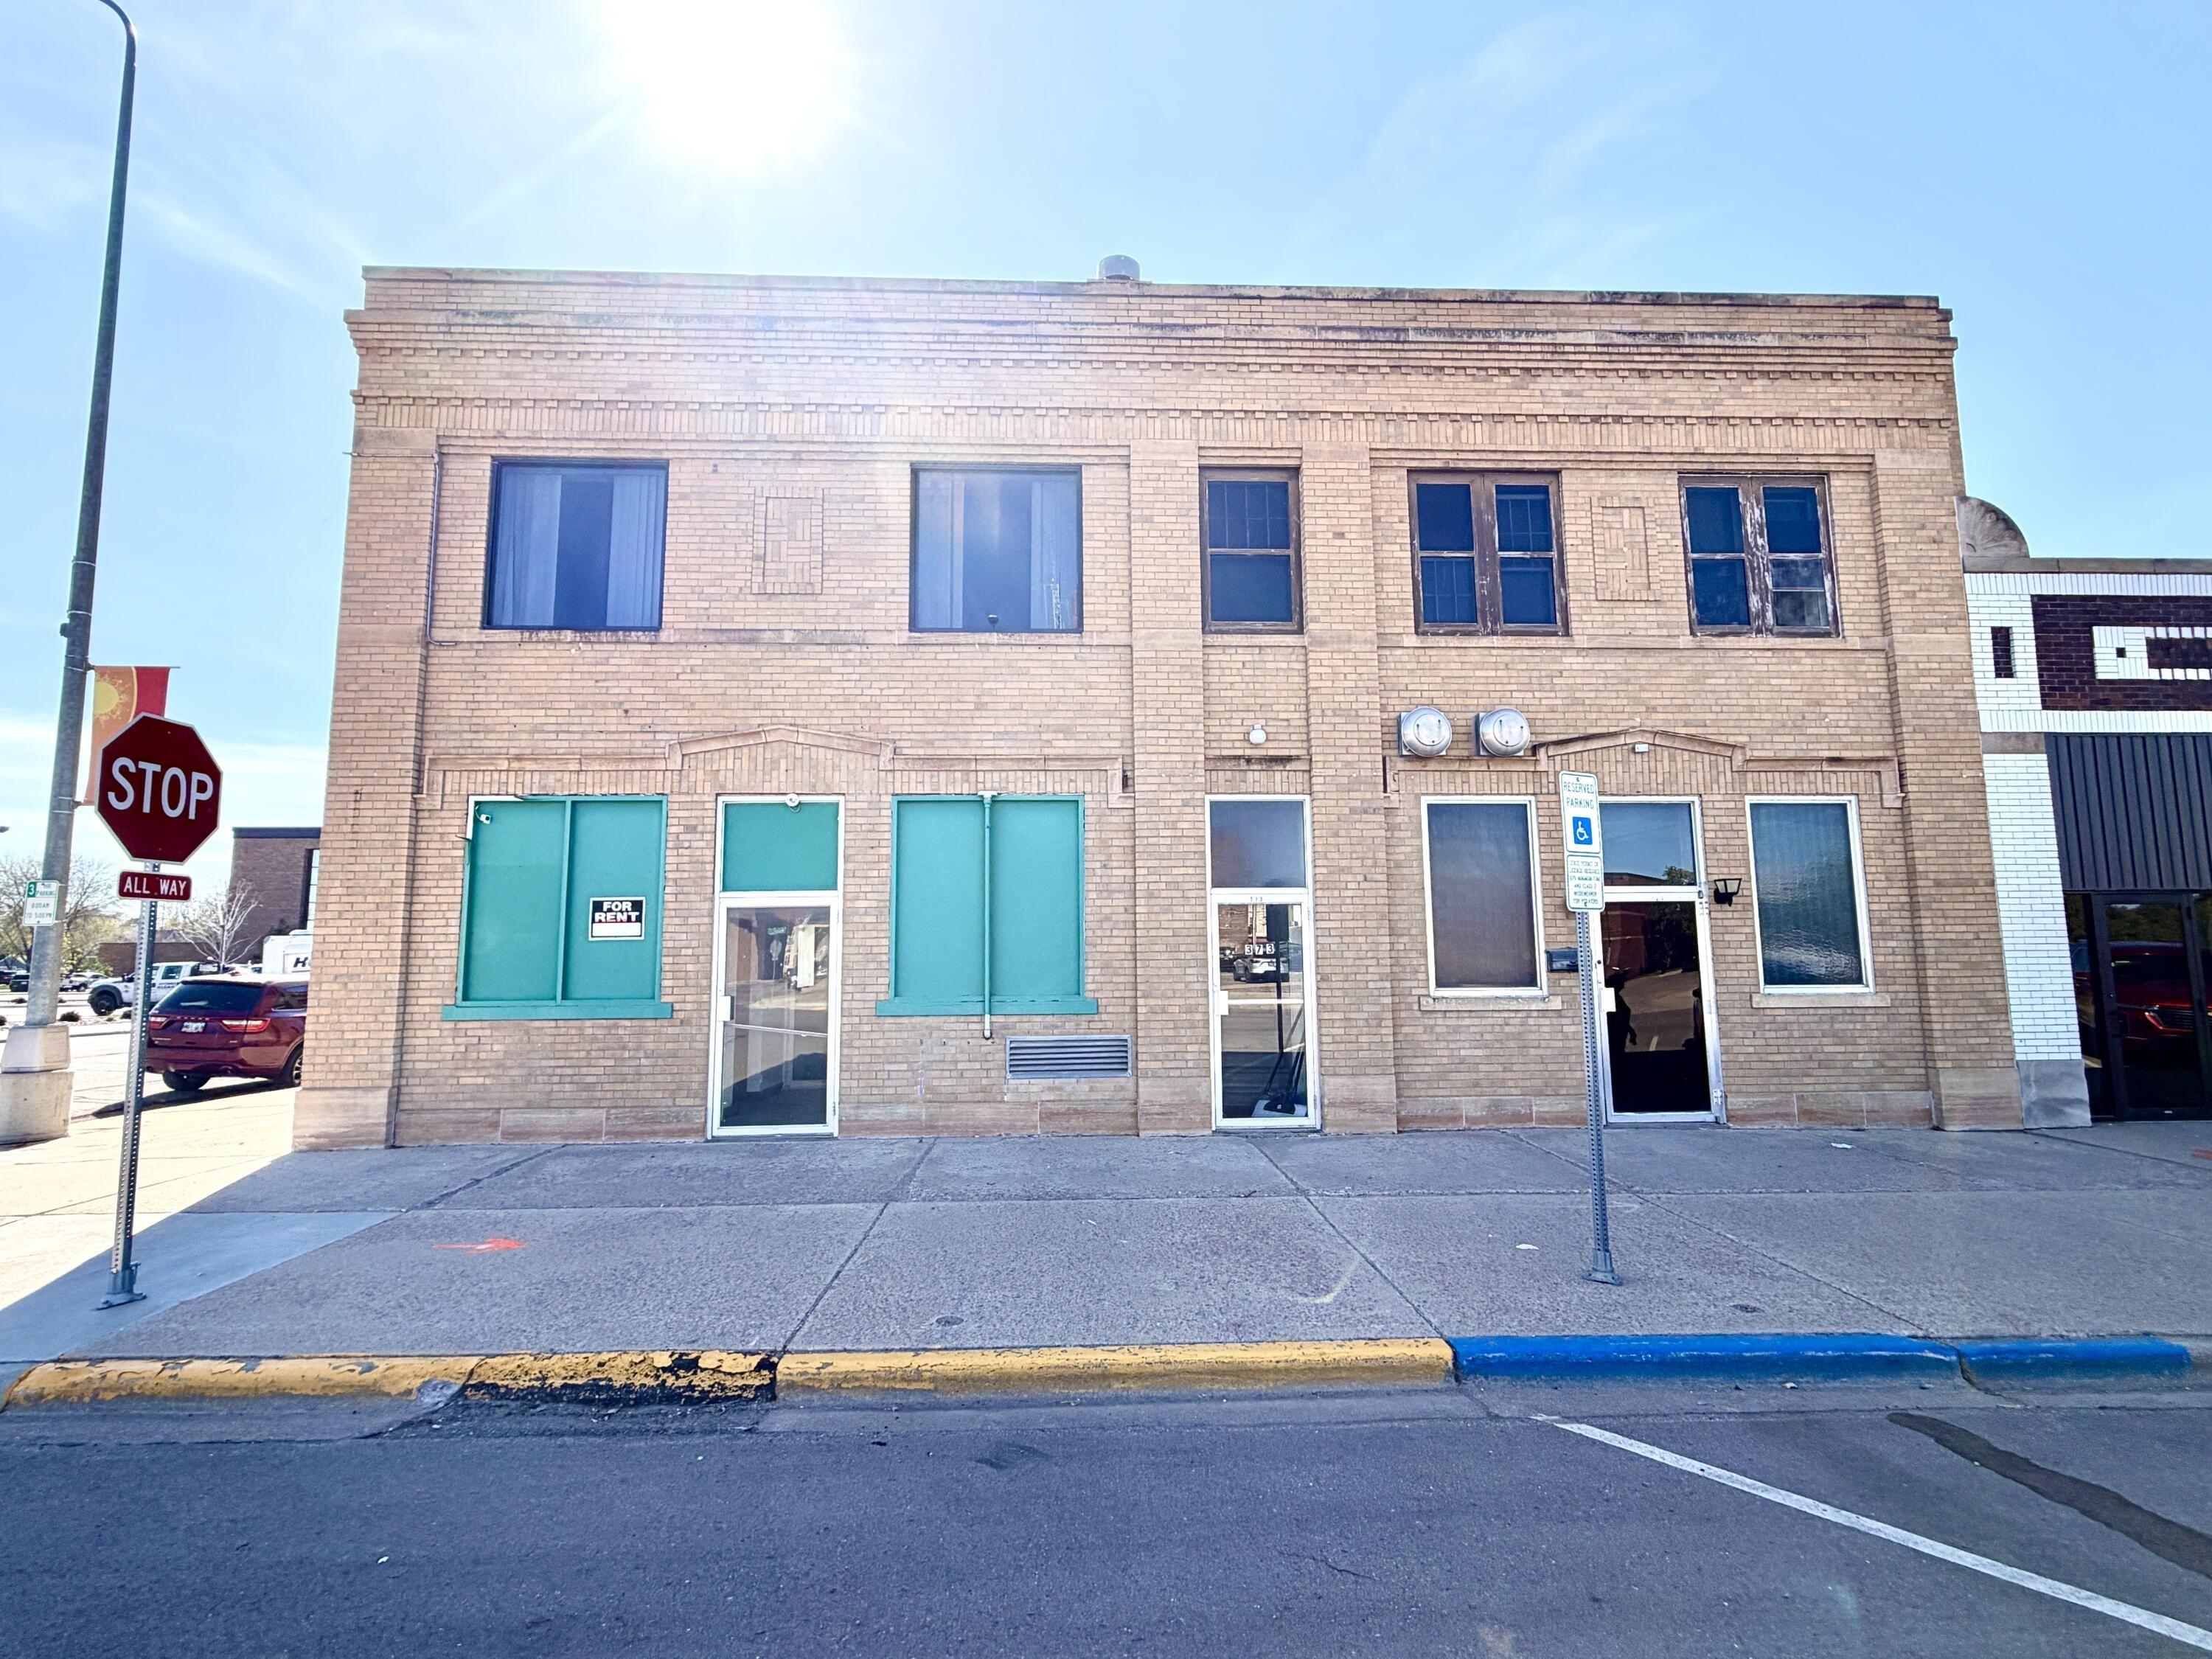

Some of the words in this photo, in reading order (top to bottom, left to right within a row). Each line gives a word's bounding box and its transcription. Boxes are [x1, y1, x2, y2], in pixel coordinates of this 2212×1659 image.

[107, 757, 214, 821] STOP
[1563, 782, 1595, 794] RESERVED
[1566, 797, 1594, 810] PARKING
[29, 883, 35, 896] 3
[123, 876, 151, 895] ALL
[159, 878, 187, 897] WAY
[602, 901, 633, 912] FOR
[594, 911, 640, 922] RENT
